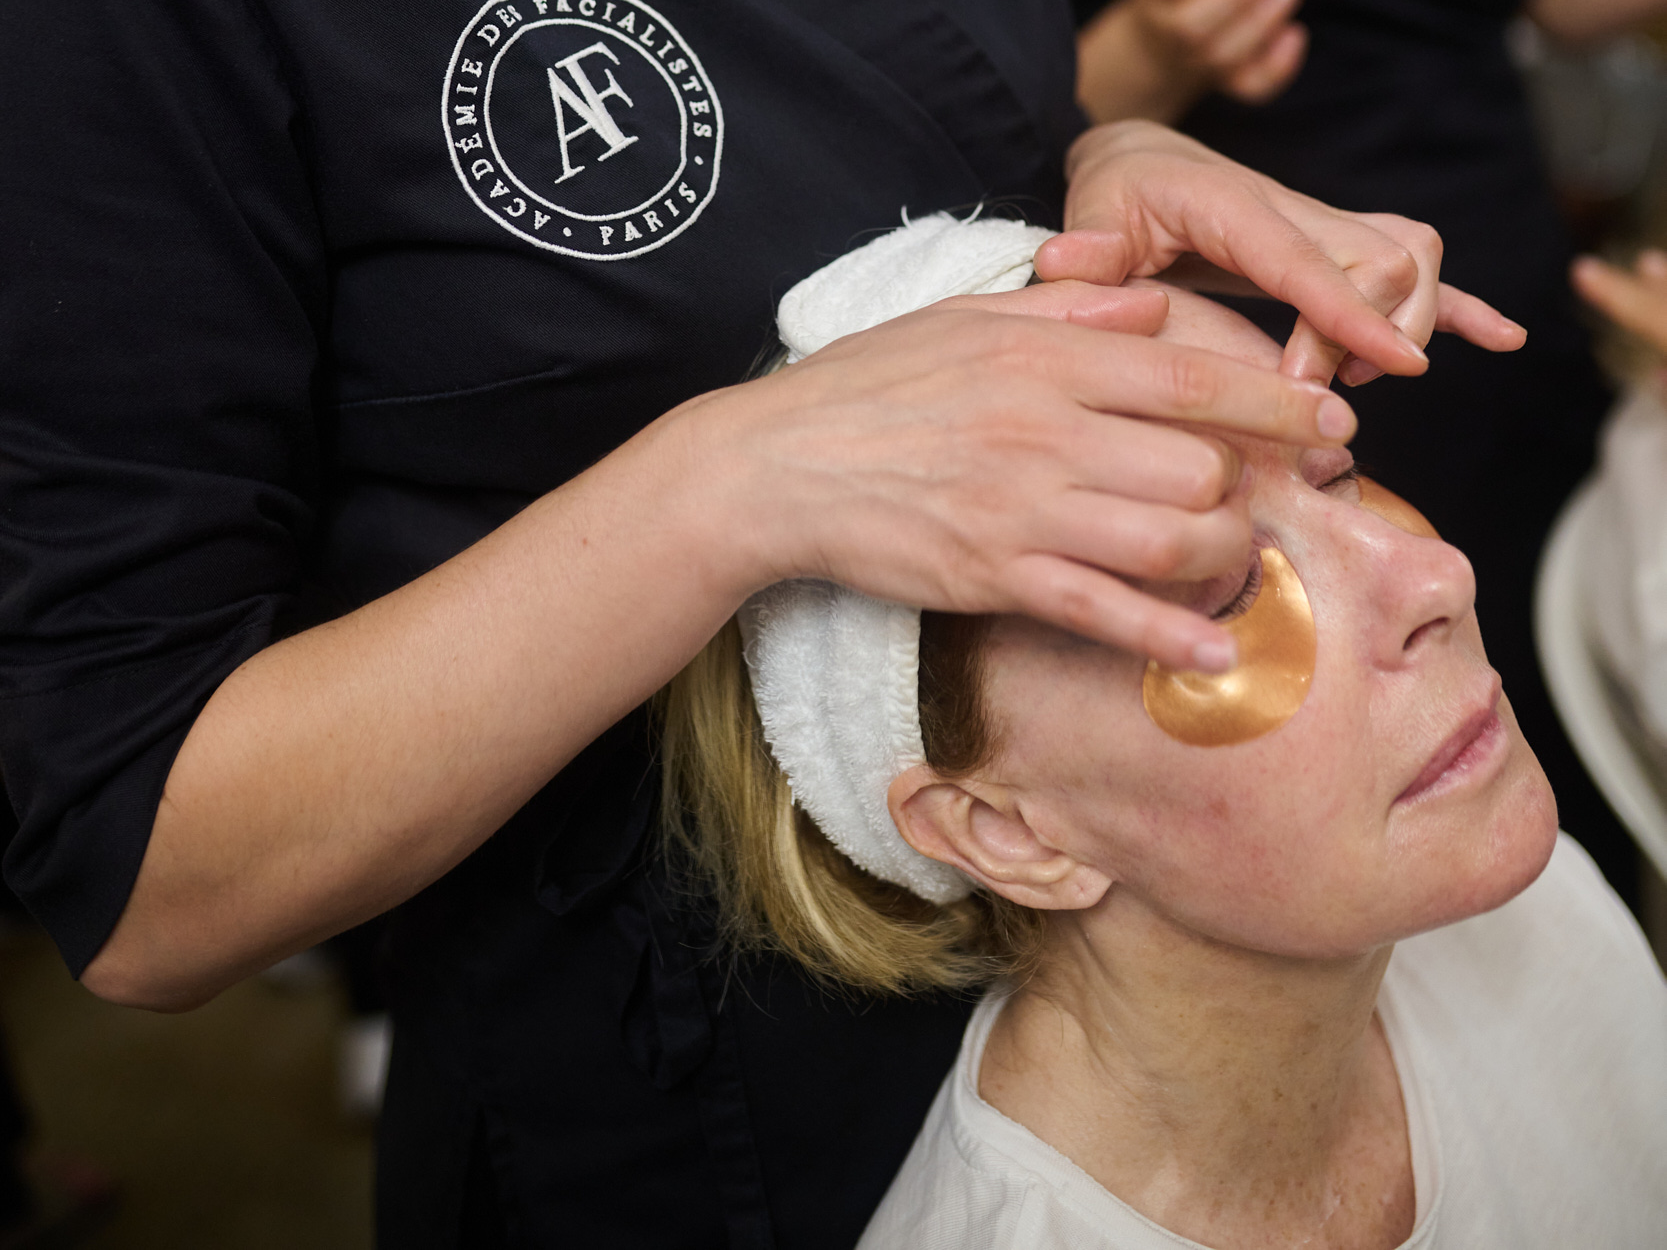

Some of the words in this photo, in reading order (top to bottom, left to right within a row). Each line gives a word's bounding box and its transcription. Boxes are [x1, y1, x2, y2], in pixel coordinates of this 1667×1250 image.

[454, 57, 552, 231] ACADÉMIE
[547, 41, 640, 184] AF
[598, 181, 697, 246] PARIS
